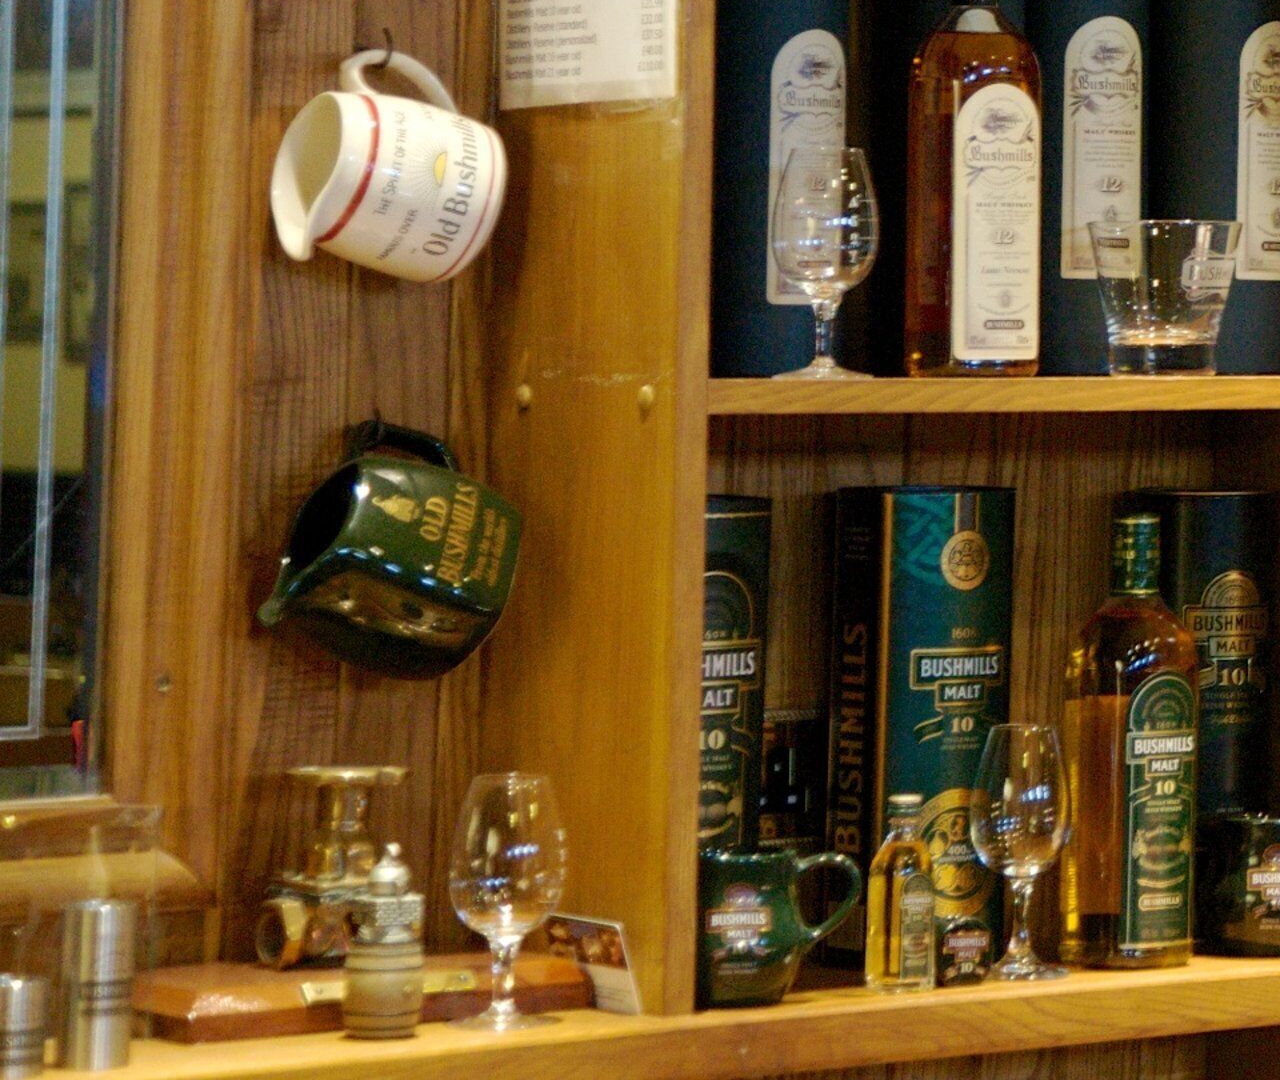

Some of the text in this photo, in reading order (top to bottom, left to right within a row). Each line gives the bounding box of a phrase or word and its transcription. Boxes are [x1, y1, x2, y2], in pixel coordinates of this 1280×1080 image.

[1075, 73, 1138, 92] Bushmills
[782, 89, 843, 109] Bushmills
[968, 144, 1033, 163] Bushmills
[373, 198, 392, 215] THE
[394, 146, 406, 159] OF
[810, 176, 826, 191] 12
[1100, 176, 1122, 192] 12
[399, 208, 418, 235] OVER
[421, 218, 462, 257] Old
[992, 230, 1016, 245] 12
[985, 321, 1024, 330] BUSHMILLS
[419, 495, 448, 542] OLD
[436, 482, 479, 583] BUSHMILLS
[1193, 614, 1265, 632] BUSHMILLS
[1216, 639, 1250, 653] MALT
[920, 655, 999, 679] BUSHMILLS
[1219, 667, 1247, 687] 10
[943, 684, 982, 701] MALT
[950, 716, 975, 733] 10
[701, 729, 727, 751] 10
[834, 622, 868, 855] BUSHMILLS
[1133, 735, 1195, 757] BUSHMILLS
[1150, 757, 1181, 773] MALT
[1153, 780, 1176, 796] 10
[1143, 897, 1181, 908] BUSHMILLS
[710, 910, 769, 927] BUSHMILLS
[727, 928, 753, 939] MALT
[948, 936, 987, 949] BUSHMILLS
[958, 951, 977, 960] MALT
[960, 961, 975, 974] 10
